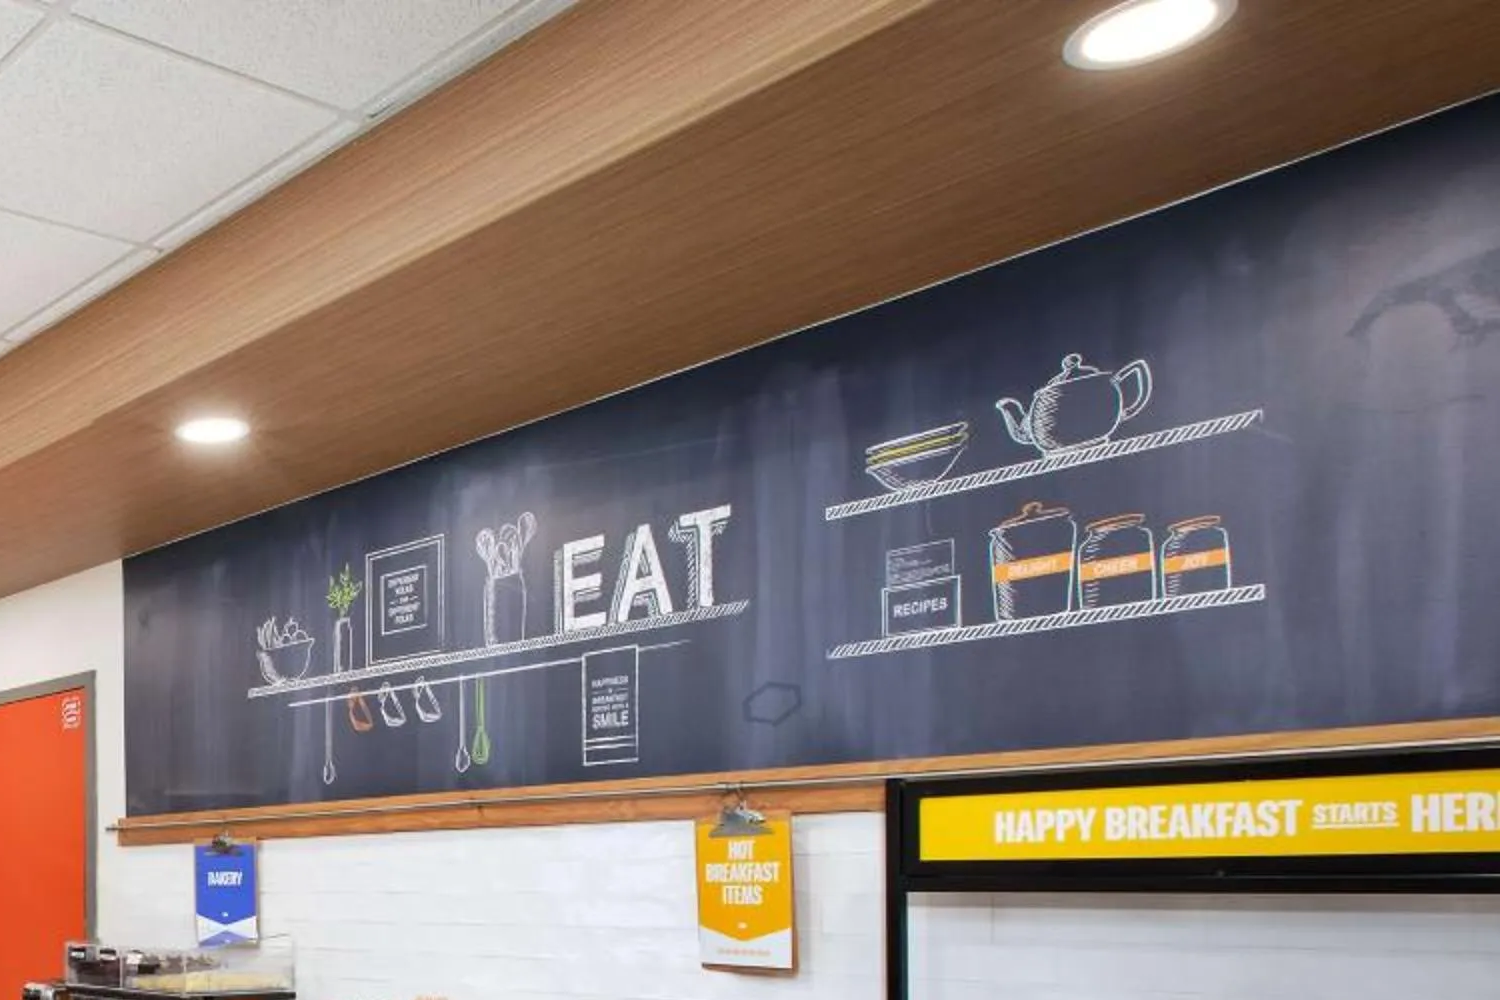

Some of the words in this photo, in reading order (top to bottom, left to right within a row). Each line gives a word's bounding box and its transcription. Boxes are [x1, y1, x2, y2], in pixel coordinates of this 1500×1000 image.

[562, 504, 731, 632] EAT
[893, 597, 949, 618] RECIPES
[592, 710, 629, 730] SMILE
[994, 807, 1097, 843] HAPPY
[1104, 798, 1304, 841] BREAKFAST
[1312, 802, 1398, 824] STARTS
[1411, 790, 1500, 832] HER
[728, 840, 755, 859] HOT
[705, 861, 780, 882] BREAKFAST
[722, 885, 764, 905] ITEMS
